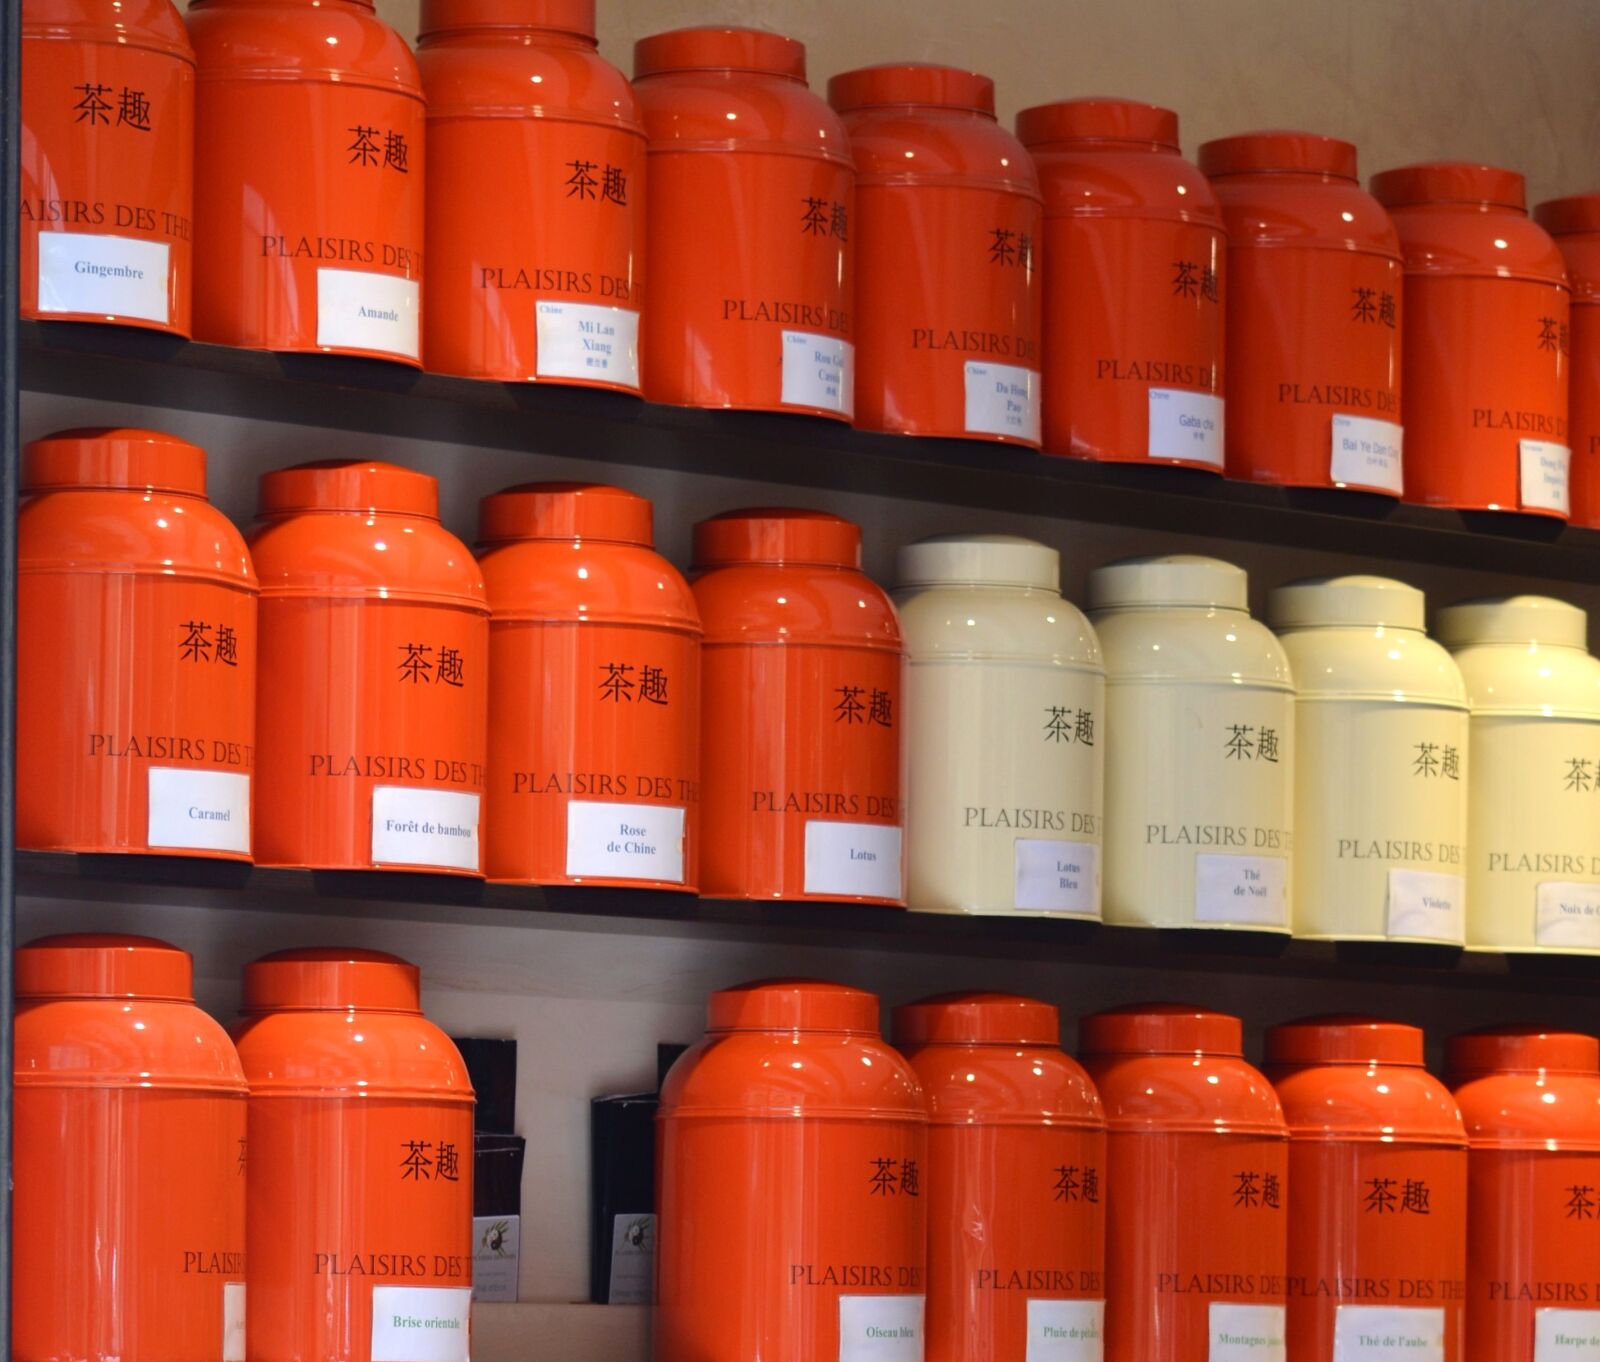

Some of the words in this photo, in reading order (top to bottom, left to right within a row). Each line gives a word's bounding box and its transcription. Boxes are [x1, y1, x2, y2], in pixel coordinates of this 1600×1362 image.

[74, 83, 151, 131] 茶趣
[347, 125, 409, 173] 茶趣
[565, 160, 627, 206] 茶趣
[115, 205, 156, 231] DES
[801, 199, 847, 241] 茶趣
[261, 235, 374, 264] PLAISIRS
[74, 260, 144, 281] Gingembre
[481, 268, 592, 294] PLAISIRS
[358, 305, 399, 322] Amande
[539, 304, 563, 315] Chine
[723, 300, 822, 329] PLAISIRS
[578, 320, 594, 333] Mi
[596, 322, 615, 336] Lan
[582, 338, 612, 356] Xiang
[912, 329, 1009, 356] PLAISIRS
[1097, 360, 1193, 384] PLAISIRS
[1278, 384, 1372, 407] PLAISIRS
[397, 643, 464, 687] 茶趣
[598, 663, 668, 705] 茶趣
[833, 686, 892, 728] 茶趣
[1044, 706, 1095, 747] 茶趣
[88, 734, 205, 760] PLAISIRS
[309, 754, 425, 780] PLAISIRS
[1412, 742, 1460, 781] 茶趣
[513, 772, 627, 797] PLAISIRS
[188, 806, 231, 822] Caramel
[752, 791, 858, 815] PLAISIRS
[386, 818, 418, 834] Forêt
[422, 821, 435, 835] de
[438, 821, 471, 838] bambou
[619, 823, 647, 837] Rose
[964, 807, 1065, 831] PLAISIRS
[1145, 825, 1247, 847] PLAISIRS
[606, 841, 621, 854] de
[624, 841, 656, 856] Chine
[850, 848, 877, 862] Lotus
[1337, 839, 1433, 862] PLAISIRS
[1057, 861, 1081, 874] Lotus
[1243, 868, 1261, 881] Thé
[1487, 852, 1584, 875] PLAISIRS
[1059, 877, 1079, 890] Bleu
[1234, 884, 1246, 896] de
[1248, 884, 1267, 898] Noël
[1559, 902, 1583, 916] Noix
[1584, 903, 1595, 916] de
[400, 1140, 459, 1182] 茶趣
[869, 1157, 920, 1197] 茶趣
[1053, 1165, 1100, 1204] 茶趣
[1363, 1178, 1430, 1215] 茶趣
[313, 1252, 426, 1276] PLAISIRS
[790, 1264, 892, 1286] PLAISIRS
[977, 1269, 1074, 1291] PLAISIRS
[1157, 1273, 1255, 1295] PLAISIRS
[1488, 1281, 1588, 1301] PLAISIRS
[393, 1315, 422, 1329] Brise
[424, 1316, 461, 1330] orientale
[866, 1325, 898, 1339] Oiseau
[1043, 1325, 1067, 1338] Pluie
[1069, 1327, 1079, 1339] de
[1359, 1335, 1379, 1347] Thé
[1382, 1336, 1396, 1347] de
[1399, 1335, 1428, 1348] l'aube
[1555, 1334, 1588, 1349] Harpe
